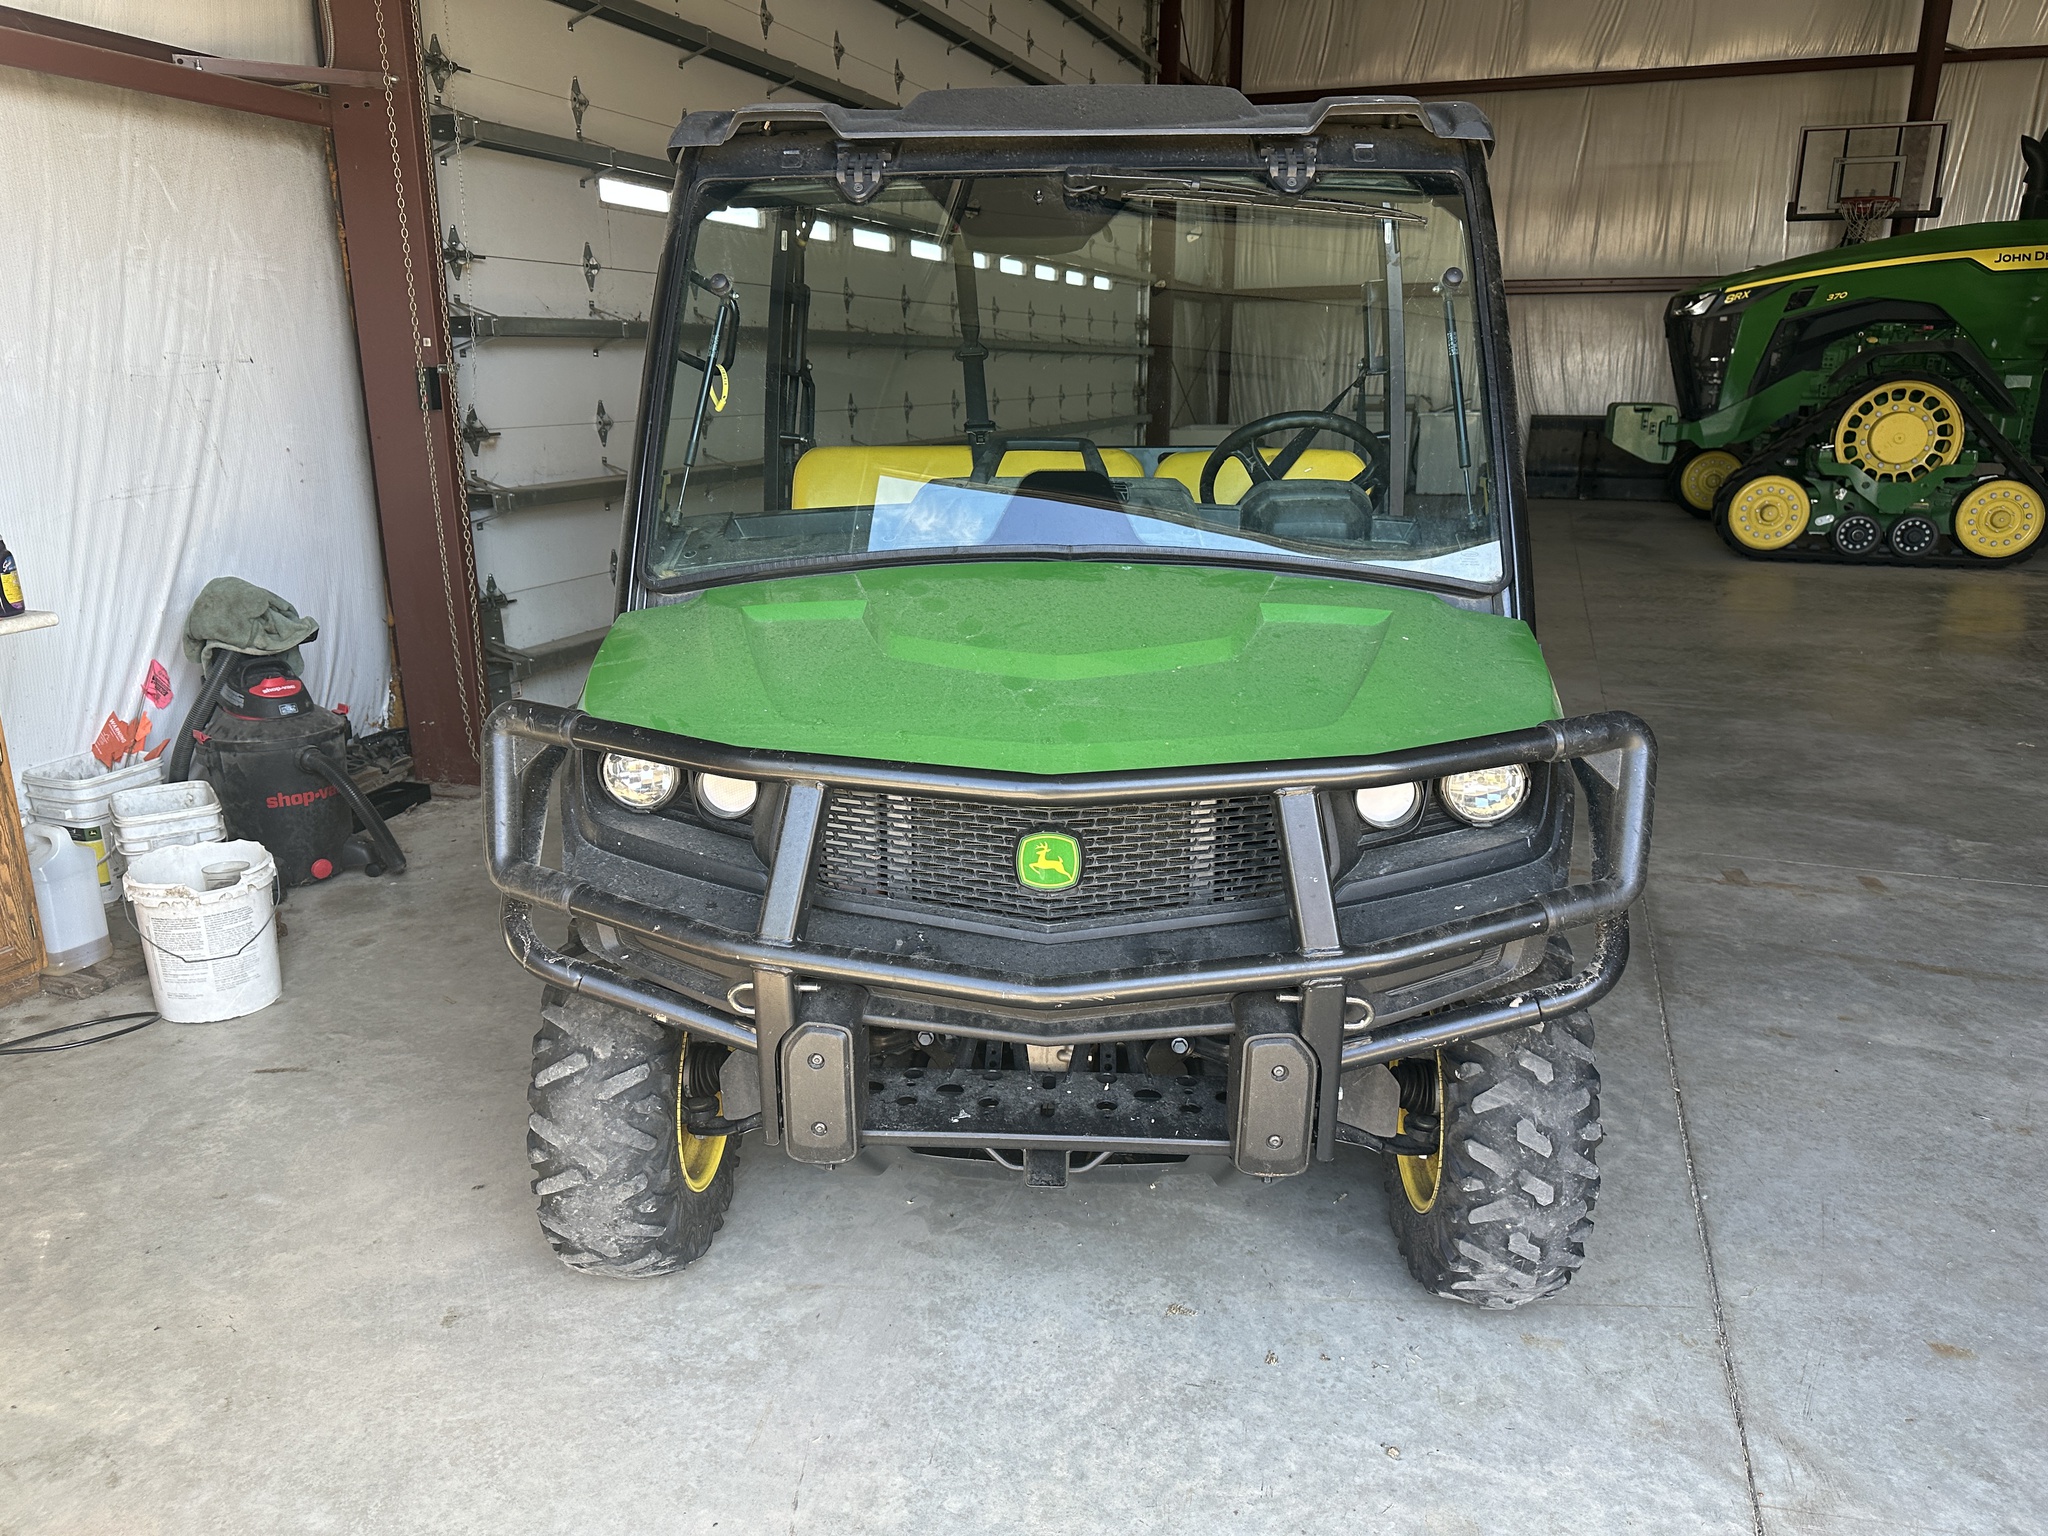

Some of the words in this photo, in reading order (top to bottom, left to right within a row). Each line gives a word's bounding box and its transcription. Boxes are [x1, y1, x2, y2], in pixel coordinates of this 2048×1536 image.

[1994, 253, 2031, 263] JOHN
[1724, 290, 1751, 304] 8RX
[1826, 291, 1848, 301] 370
[109, 718, 126, 744] WARNING
